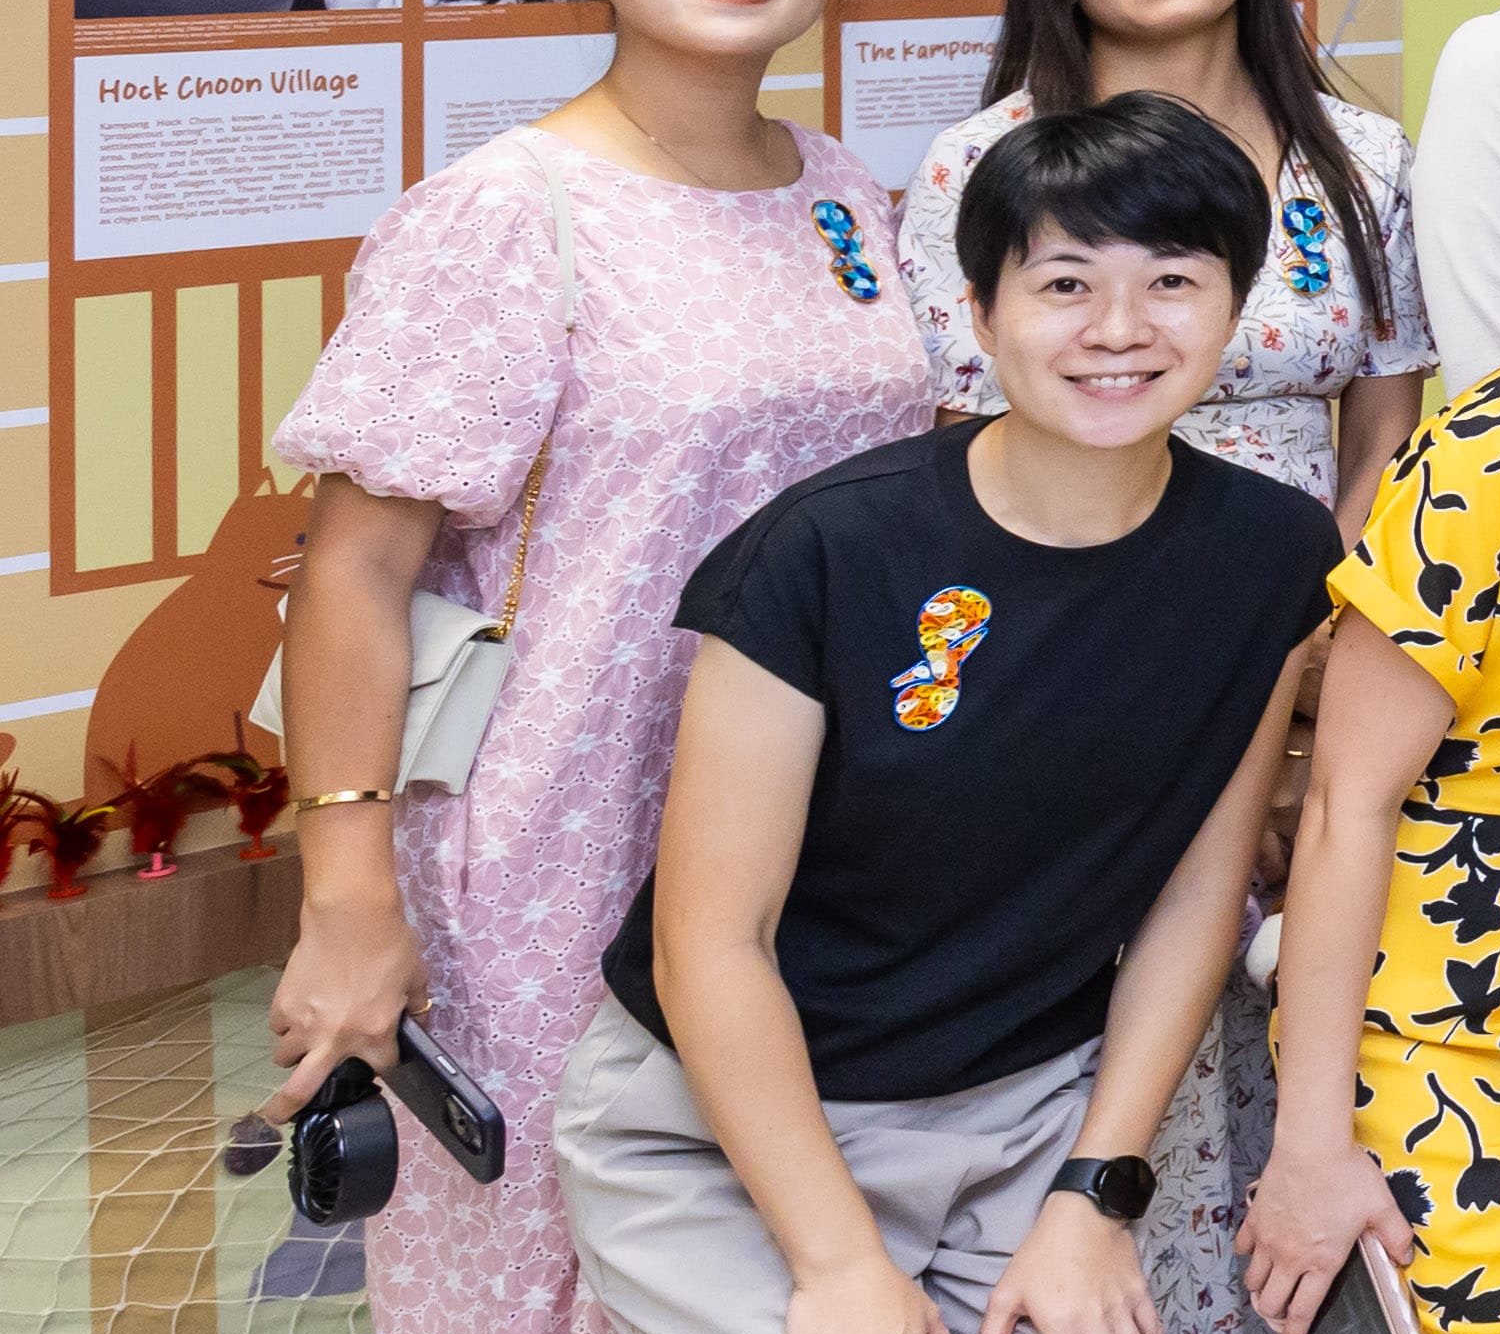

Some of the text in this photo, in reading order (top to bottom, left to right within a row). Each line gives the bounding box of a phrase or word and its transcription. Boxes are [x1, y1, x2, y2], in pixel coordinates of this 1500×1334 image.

[854, 40, 895, 63] The
[98, 66, 359, 103] Hock Choon Village
